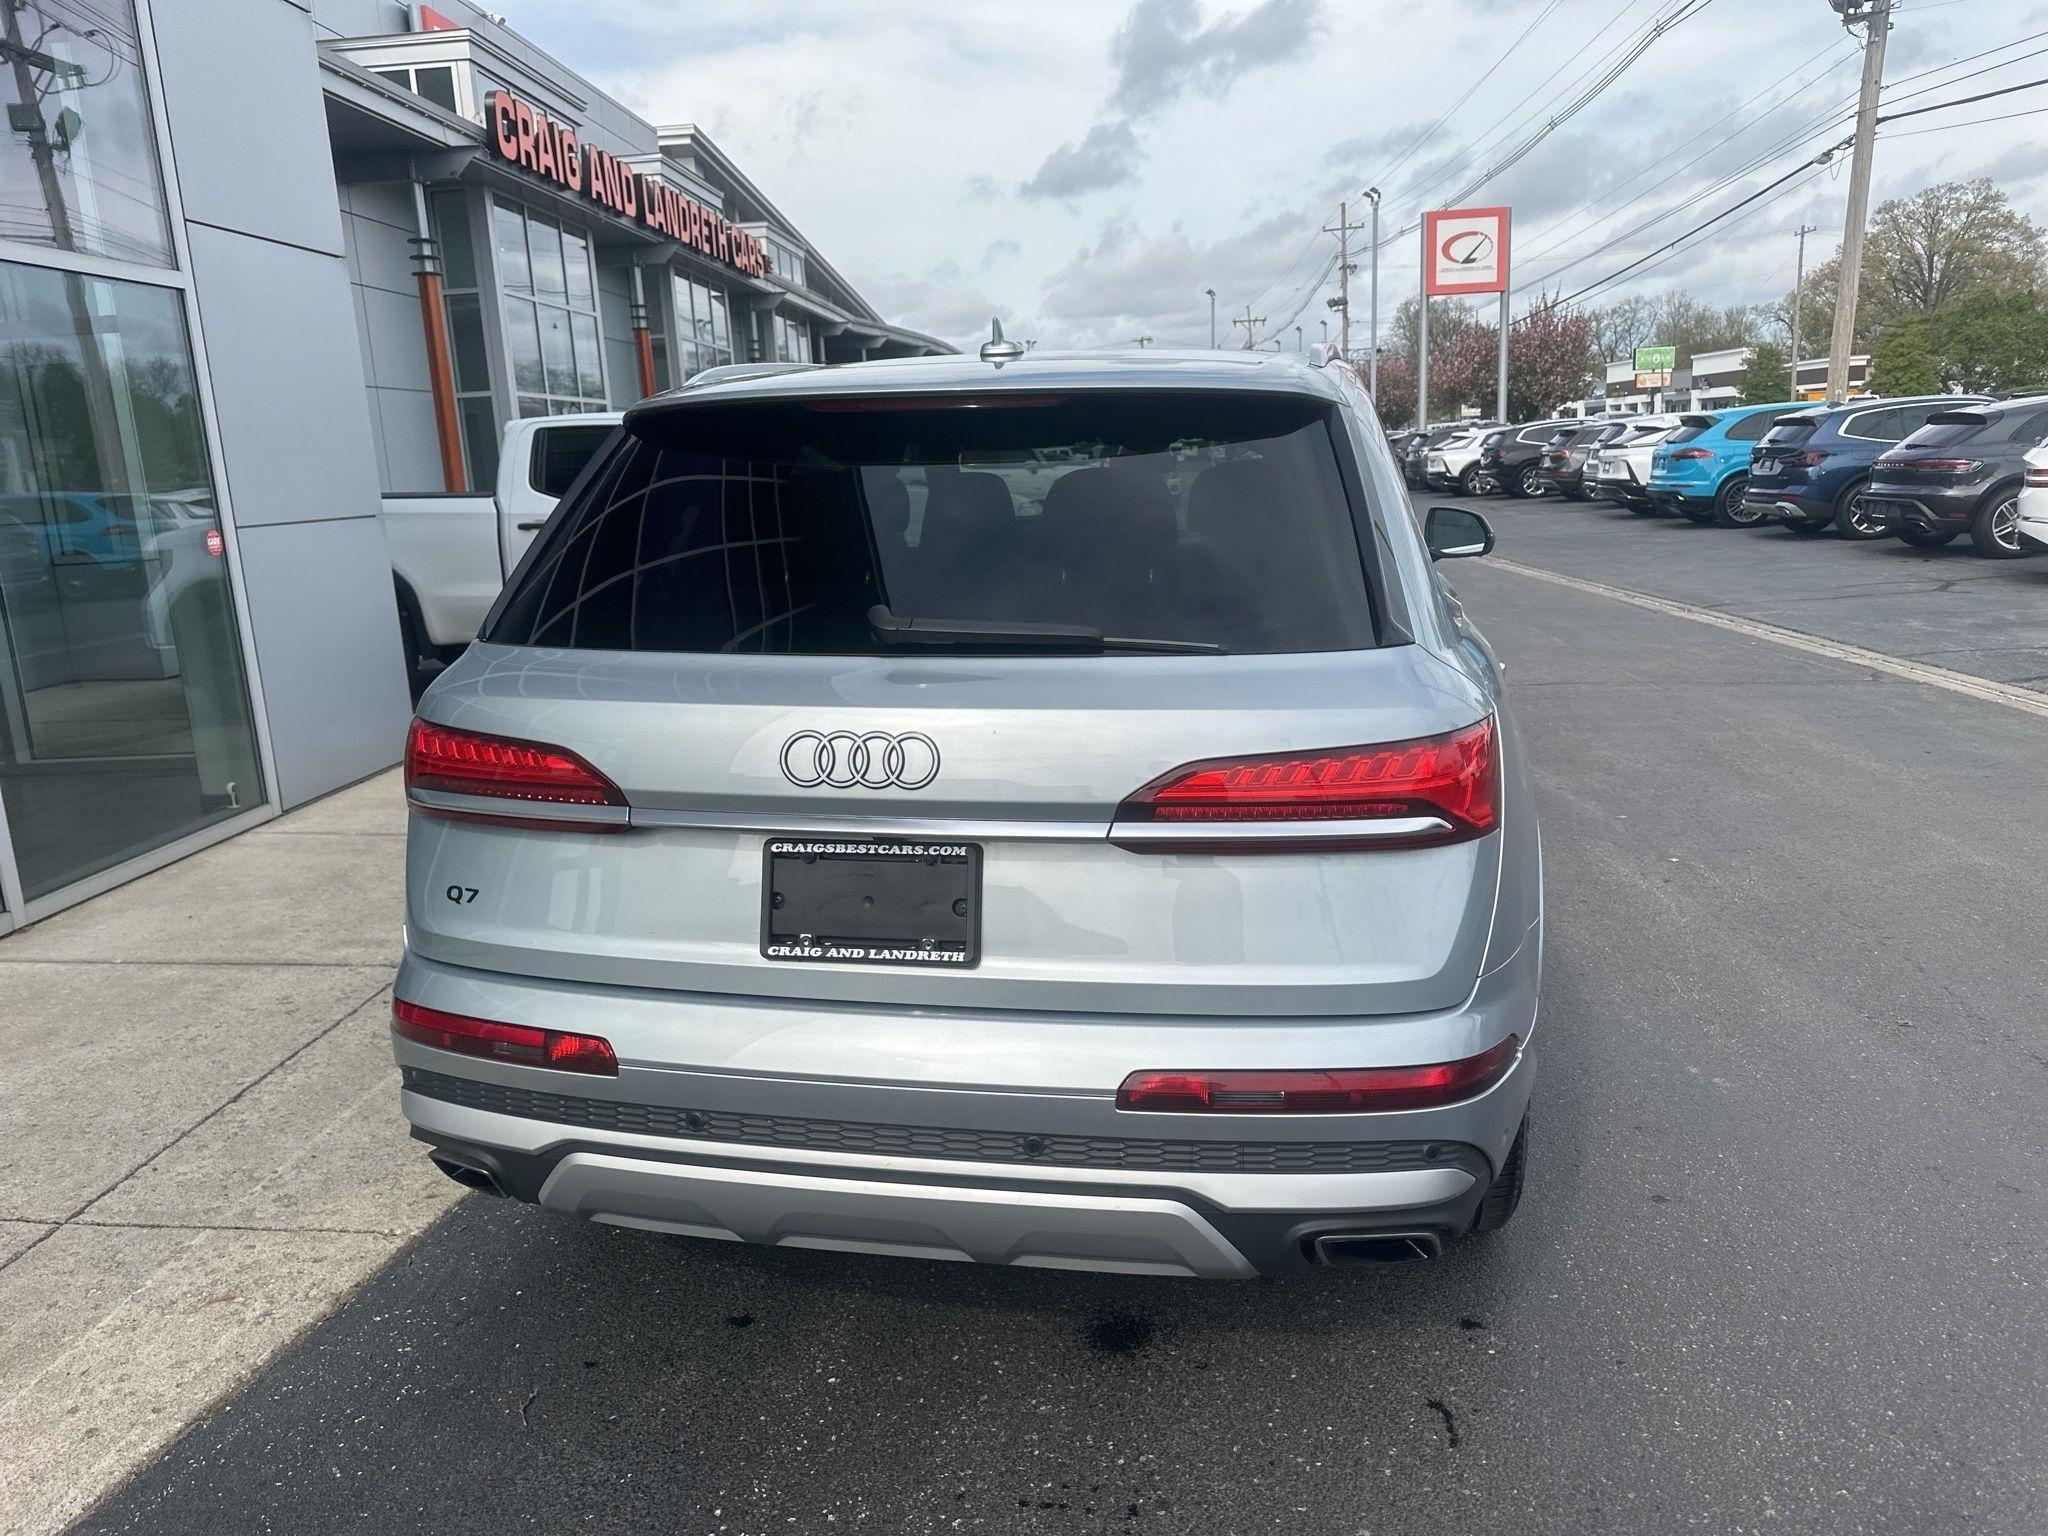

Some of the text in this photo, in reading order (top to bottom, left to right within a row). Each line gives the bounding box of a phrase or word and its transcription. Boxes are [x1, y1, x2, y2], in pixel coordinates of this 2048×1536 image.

[491, 90, 765, 279] CRAIG AND LANDRETH CARS
[770, 842, 967, 856] CRAIGSBESTCARS.COM
[446, 885, 480, 905] Q7
[767, 945, 966, 962] CRAIG AND LANDRETH
